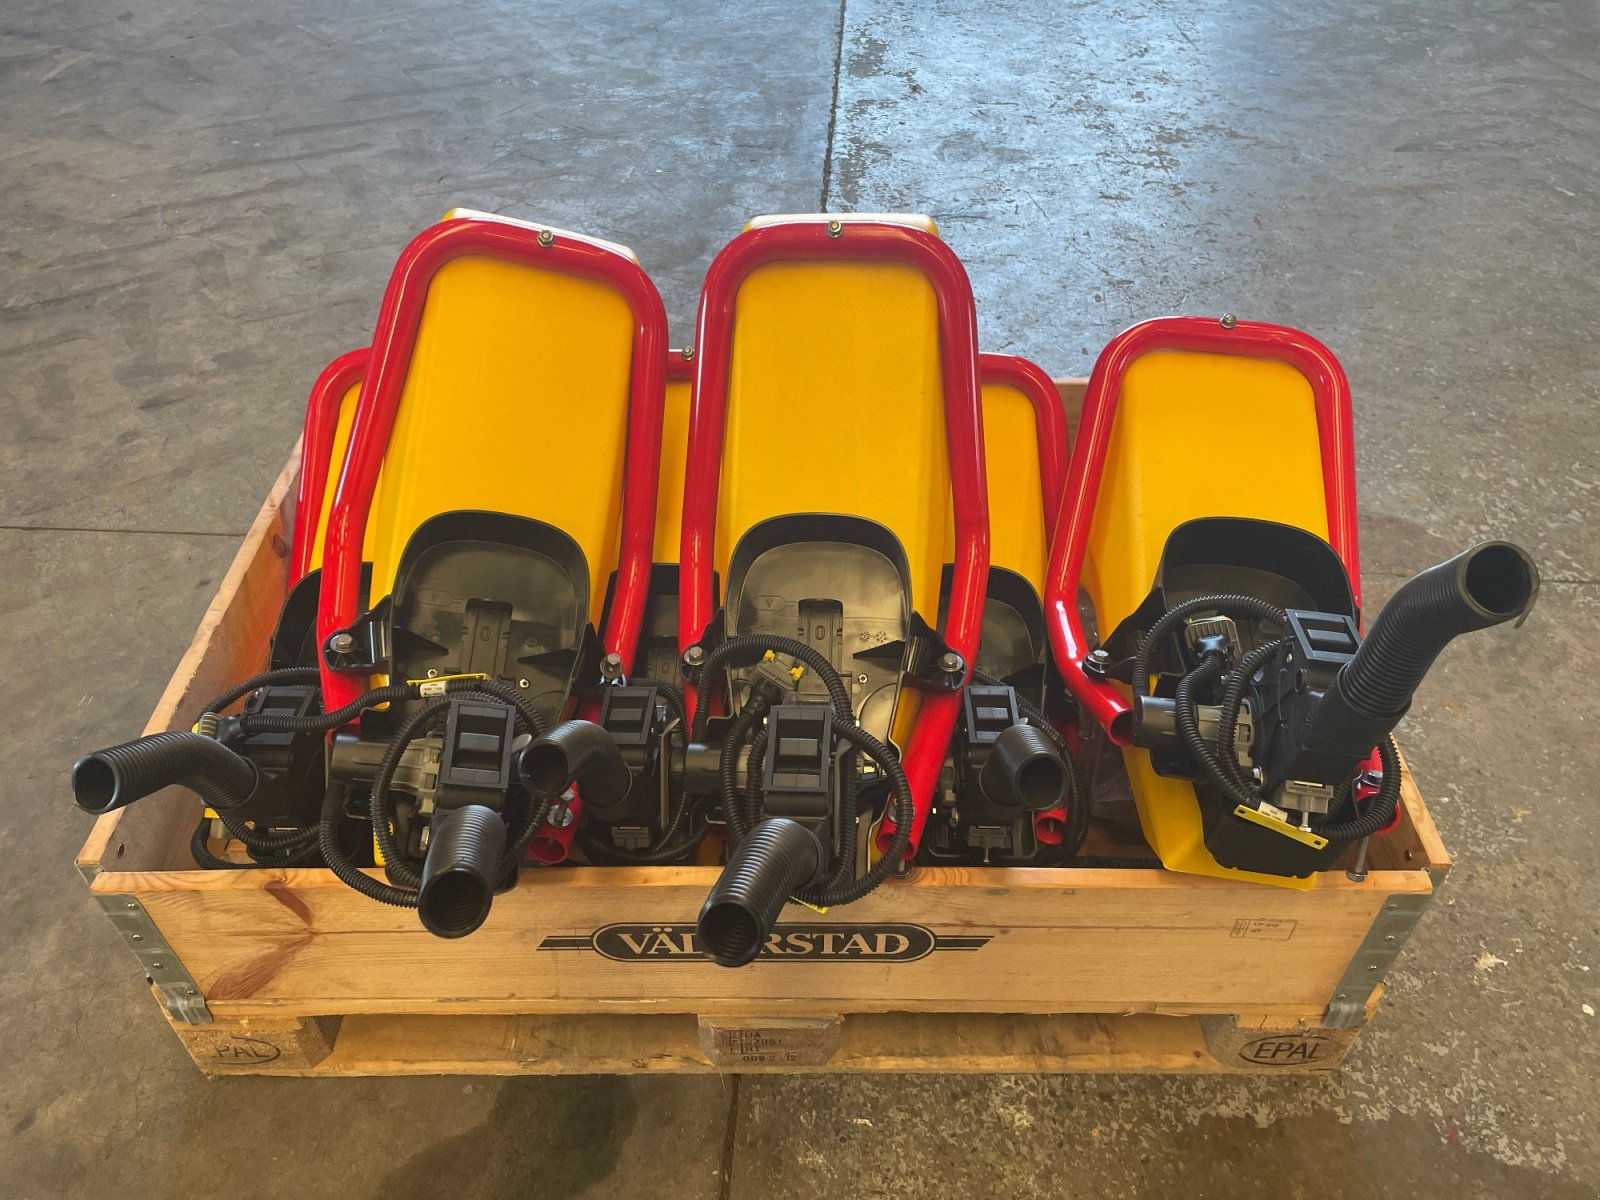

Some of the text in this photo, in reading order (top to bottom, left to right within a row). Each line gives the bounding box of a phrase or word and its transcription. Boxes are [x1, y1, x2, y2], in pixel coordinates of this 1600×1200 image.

[617, 927, 910, 954] VÄRSTAD
[212, 1044, 271, 1058] PAL
[1253, 1042, 1327, 1059] EPAL
